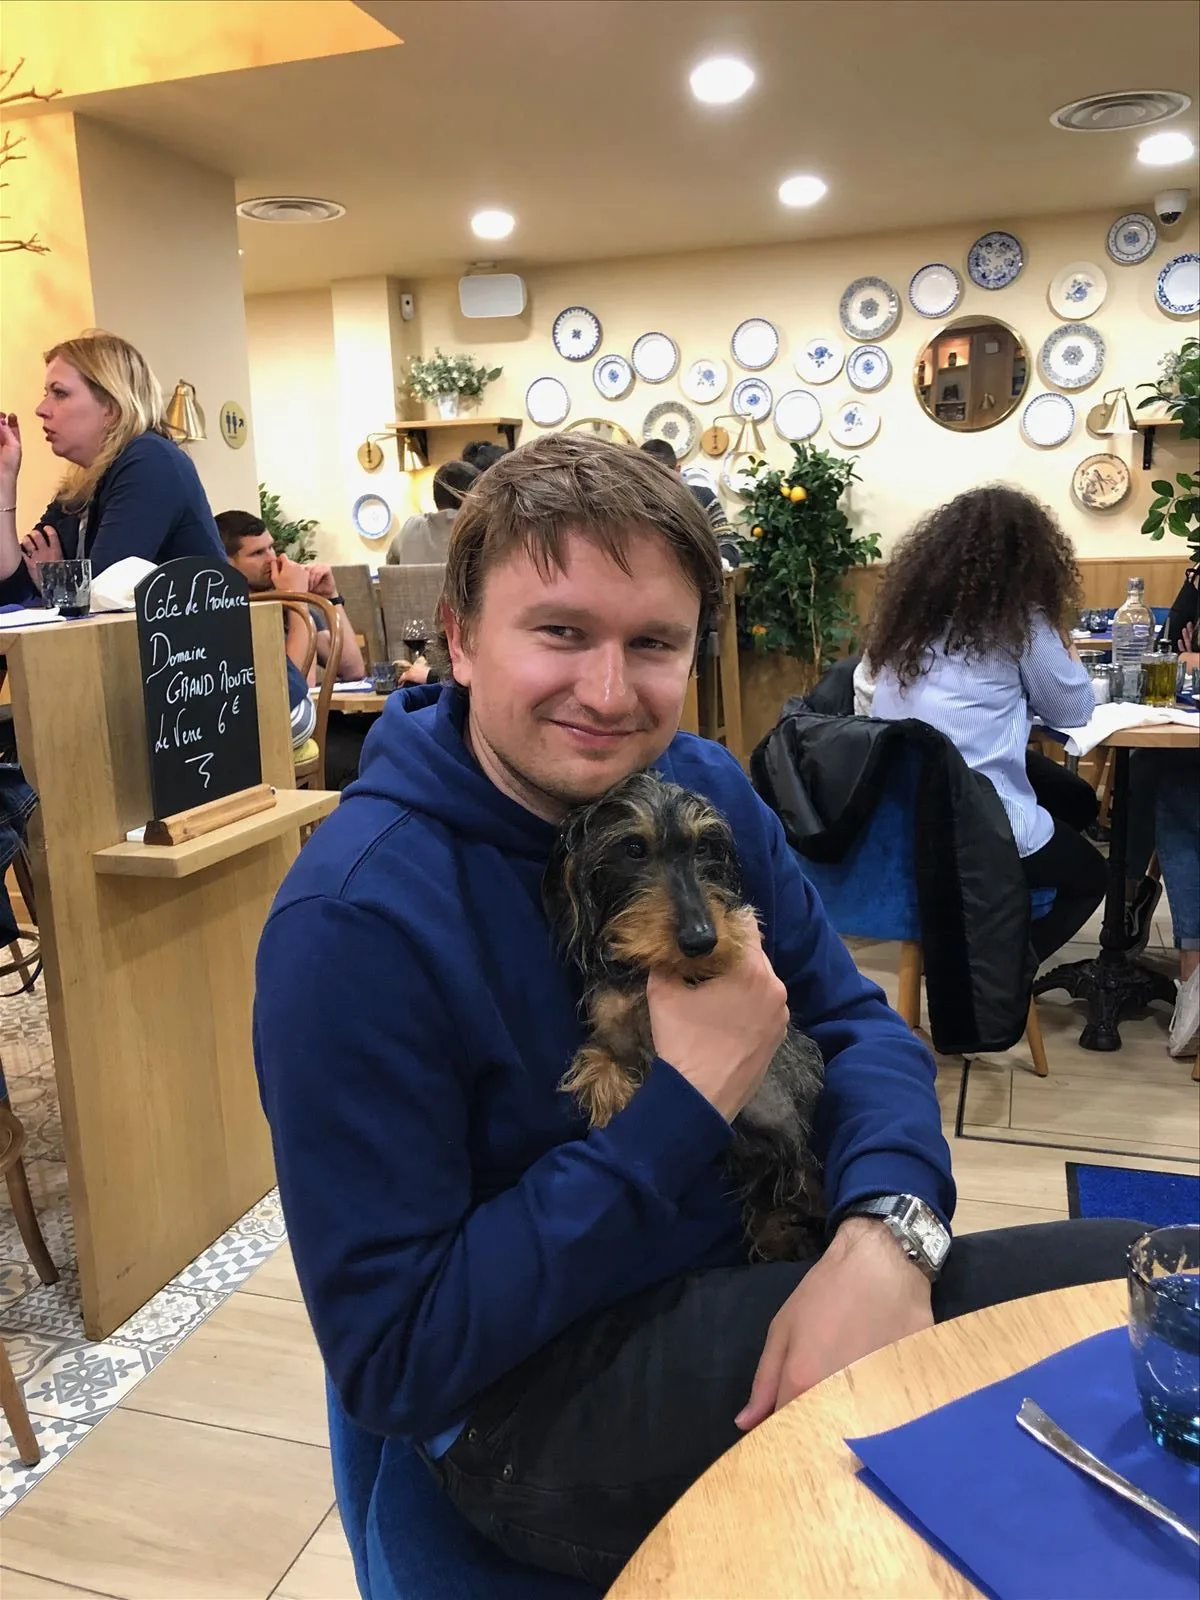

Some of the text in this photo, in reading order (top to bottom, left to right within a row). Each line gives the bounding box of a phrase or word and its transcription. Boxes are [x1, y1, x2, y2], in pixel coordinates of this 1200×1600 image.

[144, 569, 248, 622] Côte de Provence
[147, 632, 207, 683] Domaine
[166, 660, 256, 704] GRAND ROUTE
